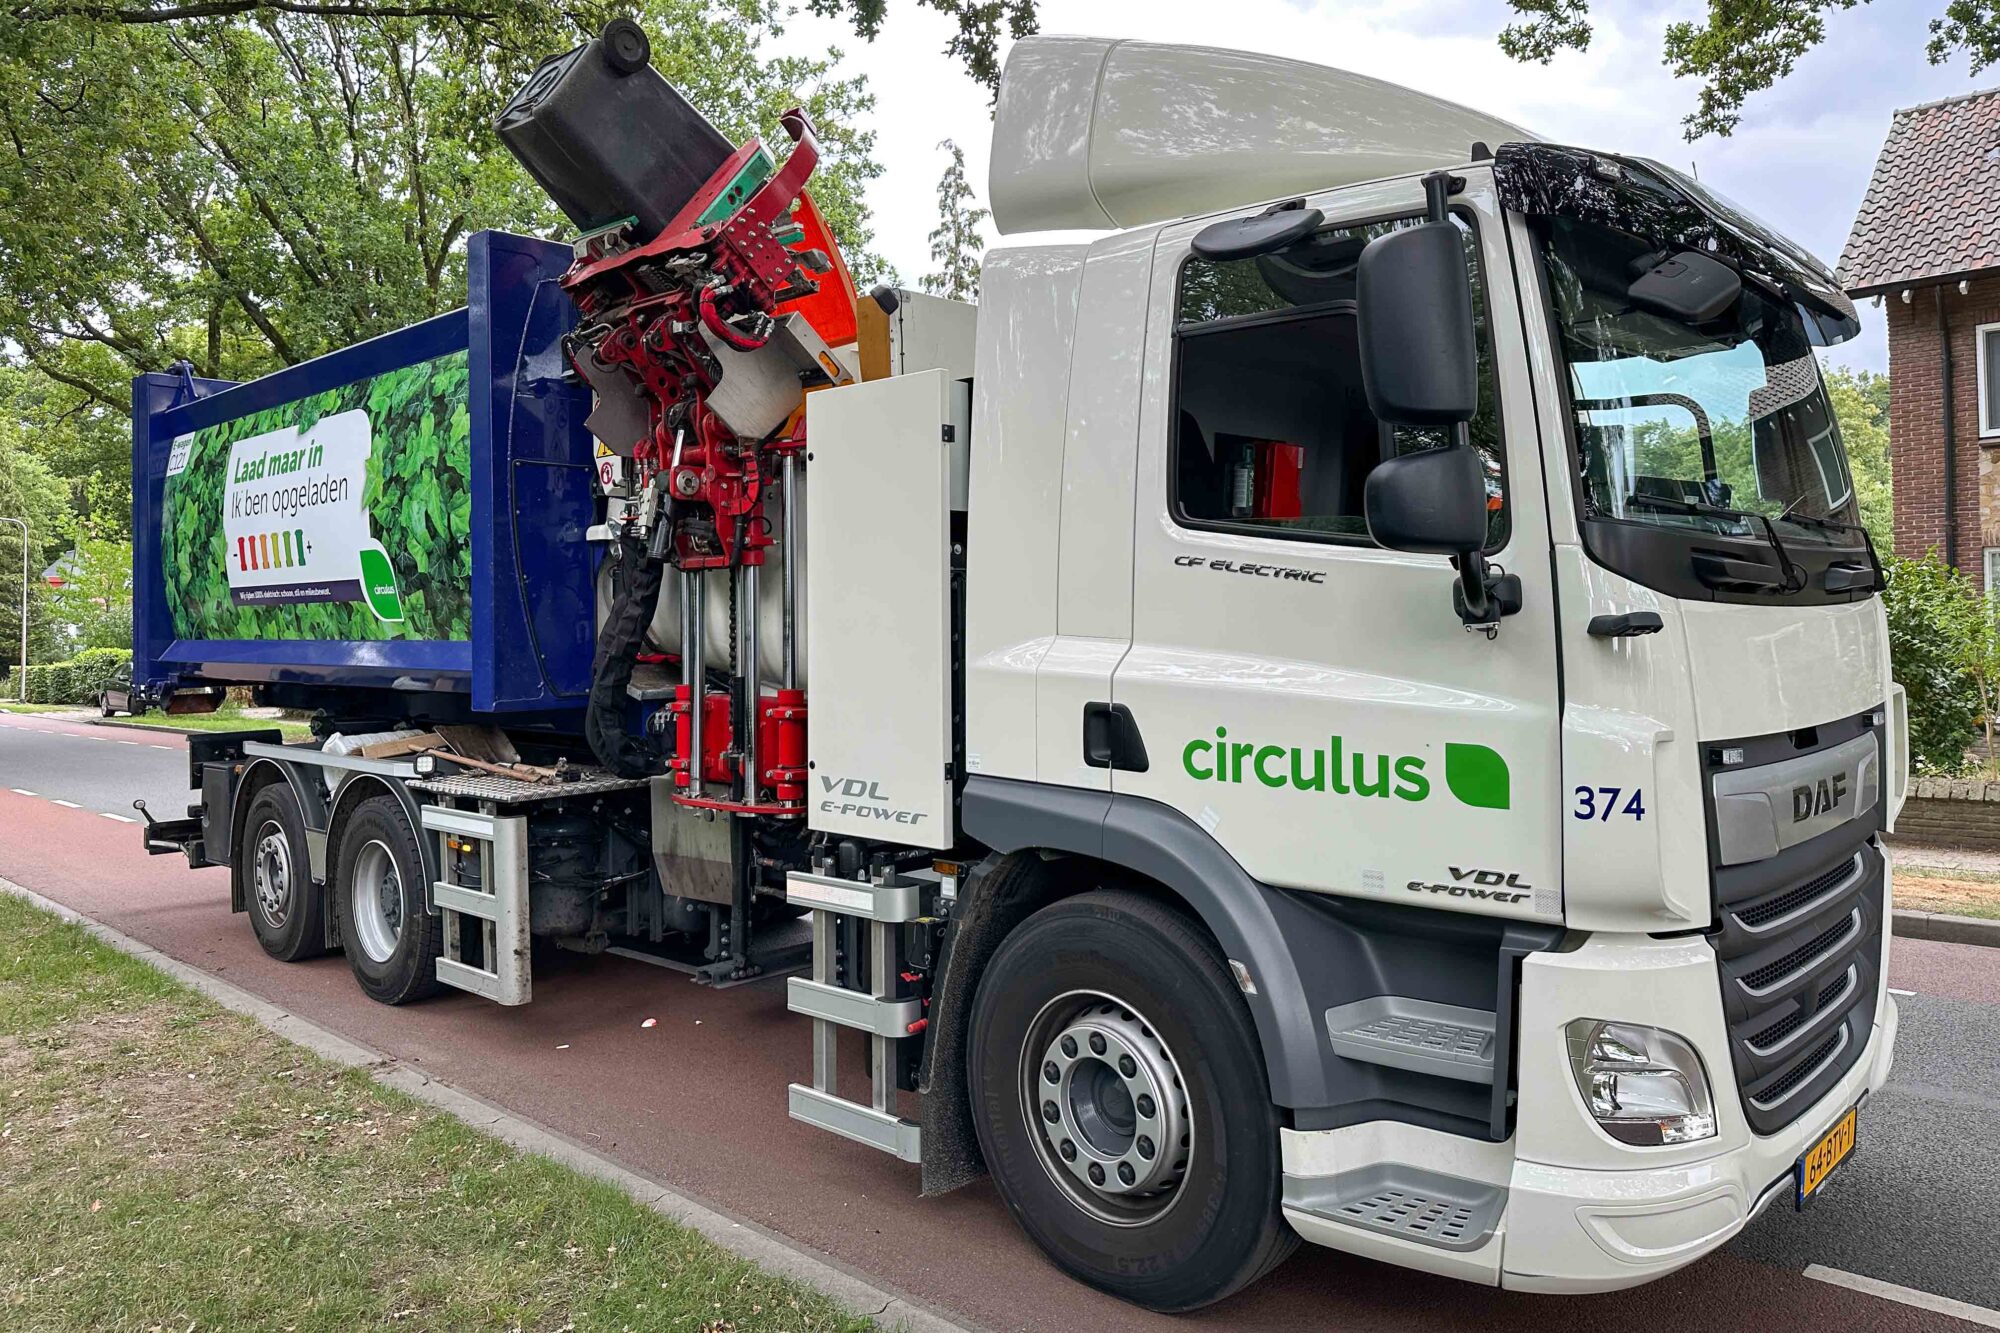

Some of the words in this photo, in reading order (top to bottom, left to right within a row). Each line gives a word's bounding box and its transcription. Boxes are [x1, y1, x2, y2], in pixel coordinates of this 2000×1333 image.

[234, 450, 267, 484] Laad
[268, 448, 306, 477] maar
[308, 439, 323, 469] in
[232, 491, 241, 519] Ik
[245, 489, 268, 517] ben
[272, 473, 348, 519] opgeladen
[1174, 555, 1206, 567] CF
[1209, 559, 1327, 584] ELECTRIC
[1182, 726, 1431, 802] circulus
[820, 775, 890, 801] VDL
[1574, 785, 1646, 823] 374
[1792, 771, 1847, 824] DAF
[1448, 865, 1532, 890] VDL
[1810, 1118, 1851, 1184] 64-BTV-1
